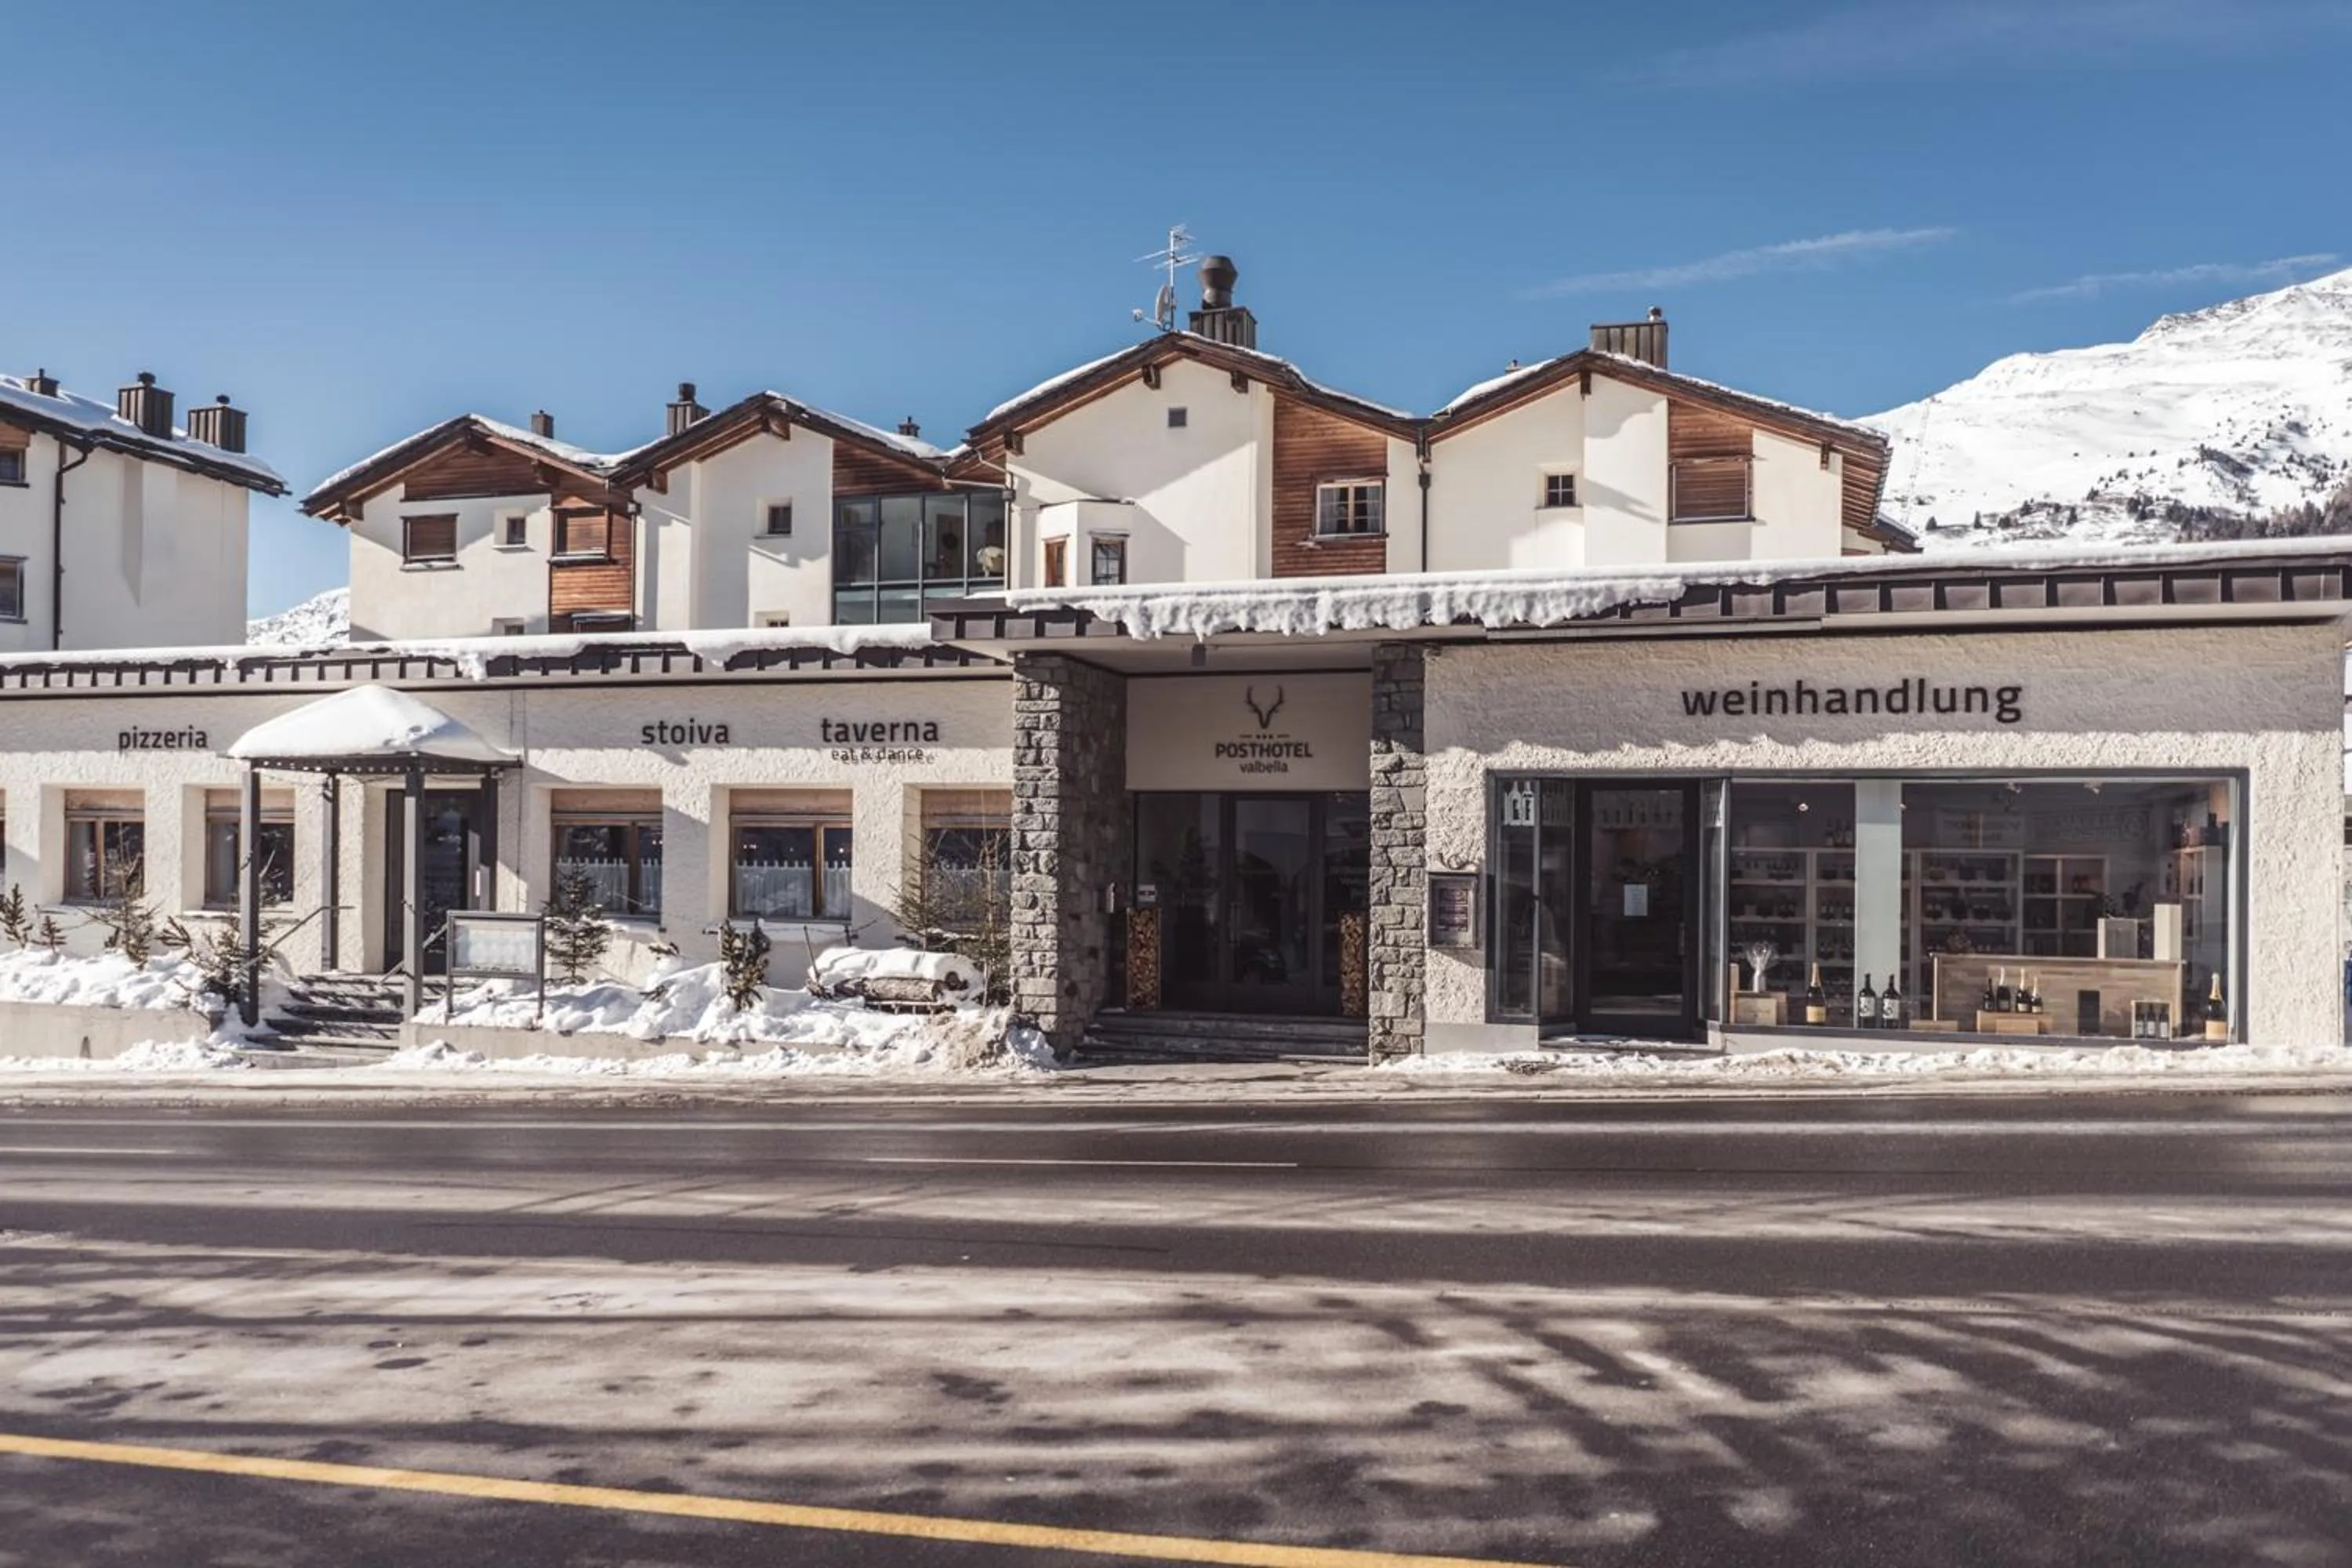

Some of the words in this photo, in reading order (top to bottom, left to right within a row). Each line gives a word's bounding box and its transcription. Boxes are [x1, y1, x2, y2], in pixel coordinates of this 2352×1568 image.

[1682, 679, 2022, 723] weinhandlung
[118, 724, 208, 757] pizzeria
[641, 717, 730, 744] stoiva
[821, 717, 939, 742] taverna
[831, 747, 855, 761] eat
[861, 746, 872, 760] &
[877, 746, 924, 760] dance
[1215, 742, 1313, 758] POSTHOTEL
[1240, 760, 1288, 773] valbella
